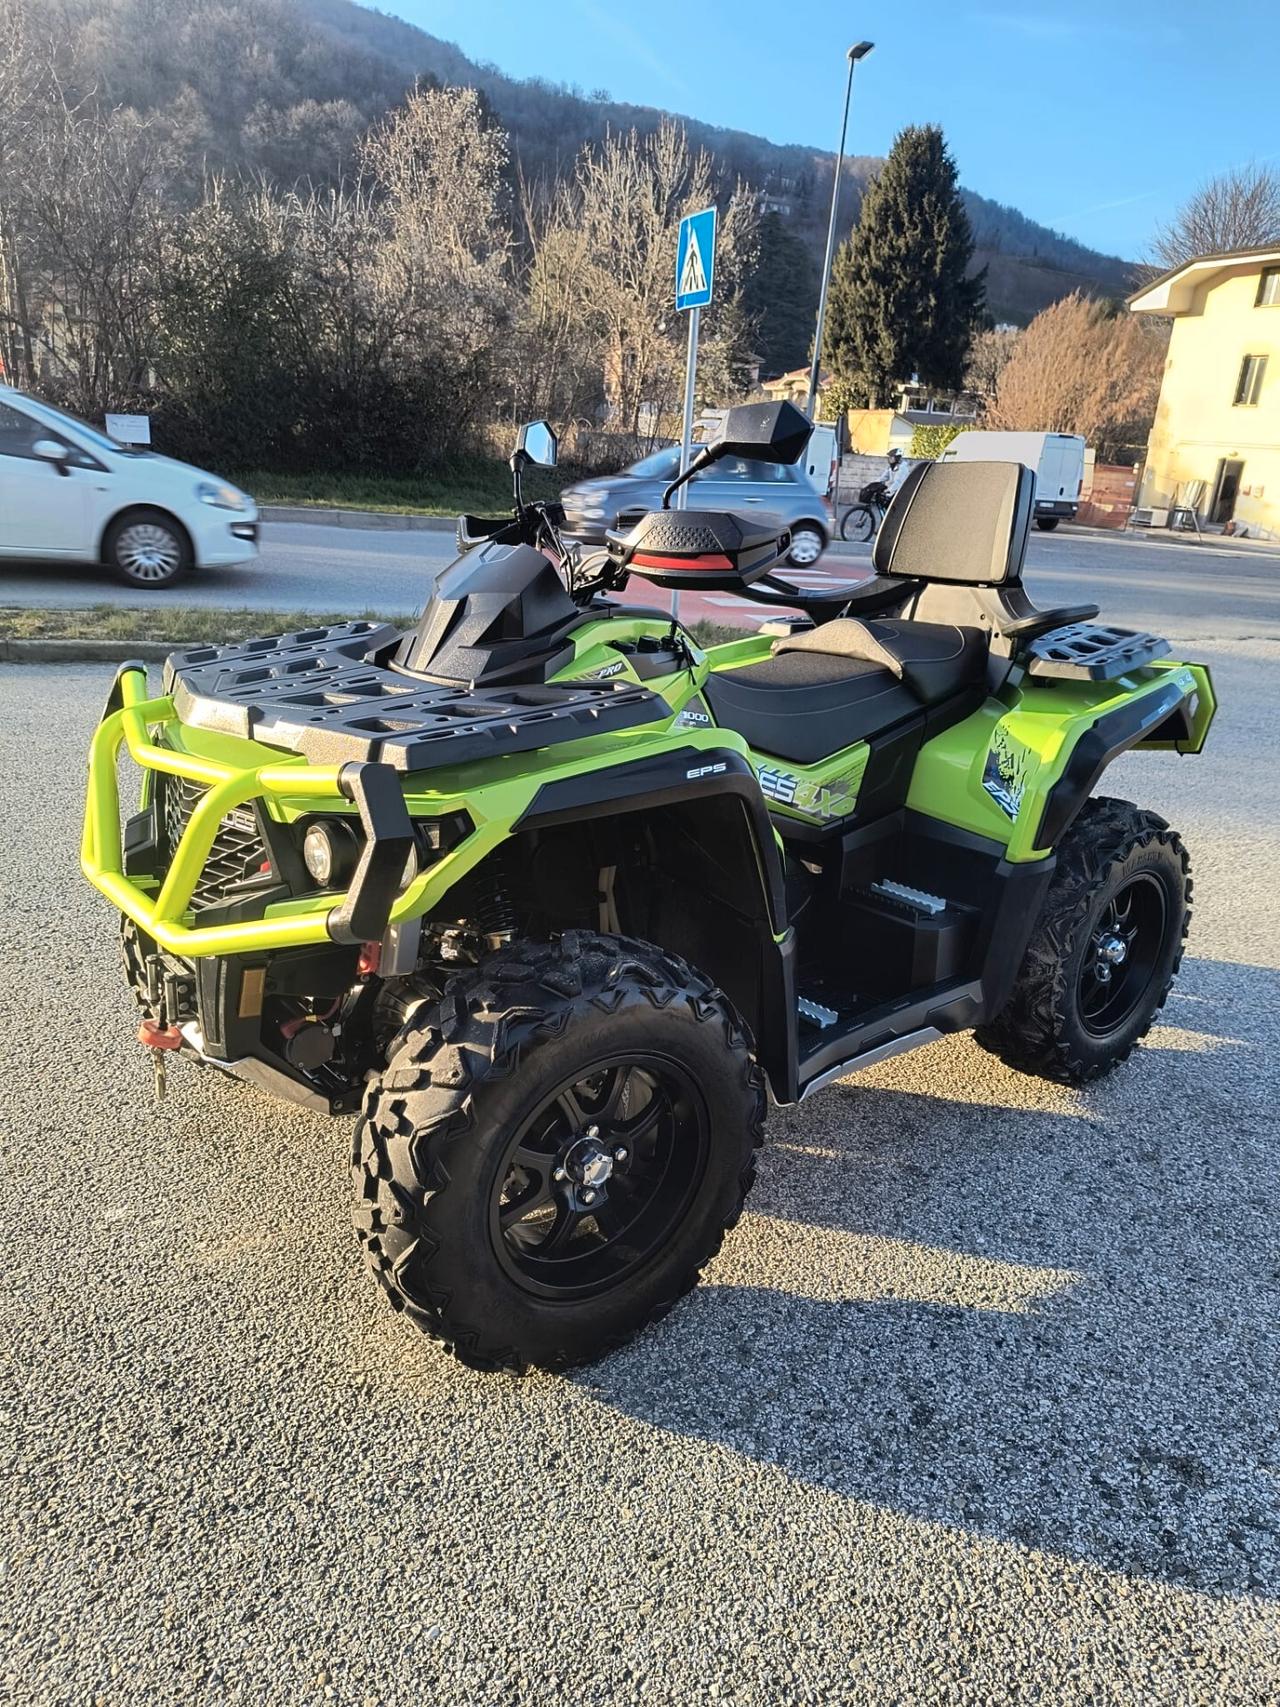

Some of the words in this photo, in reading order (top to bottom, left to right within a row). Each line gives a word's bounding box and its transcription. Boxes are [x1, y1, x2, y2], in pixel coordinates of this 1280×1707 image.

[598, 662, 623, 680] PRO
[682, 710, 709, 723] 1000
[686, 762, 727, 779] EPS
